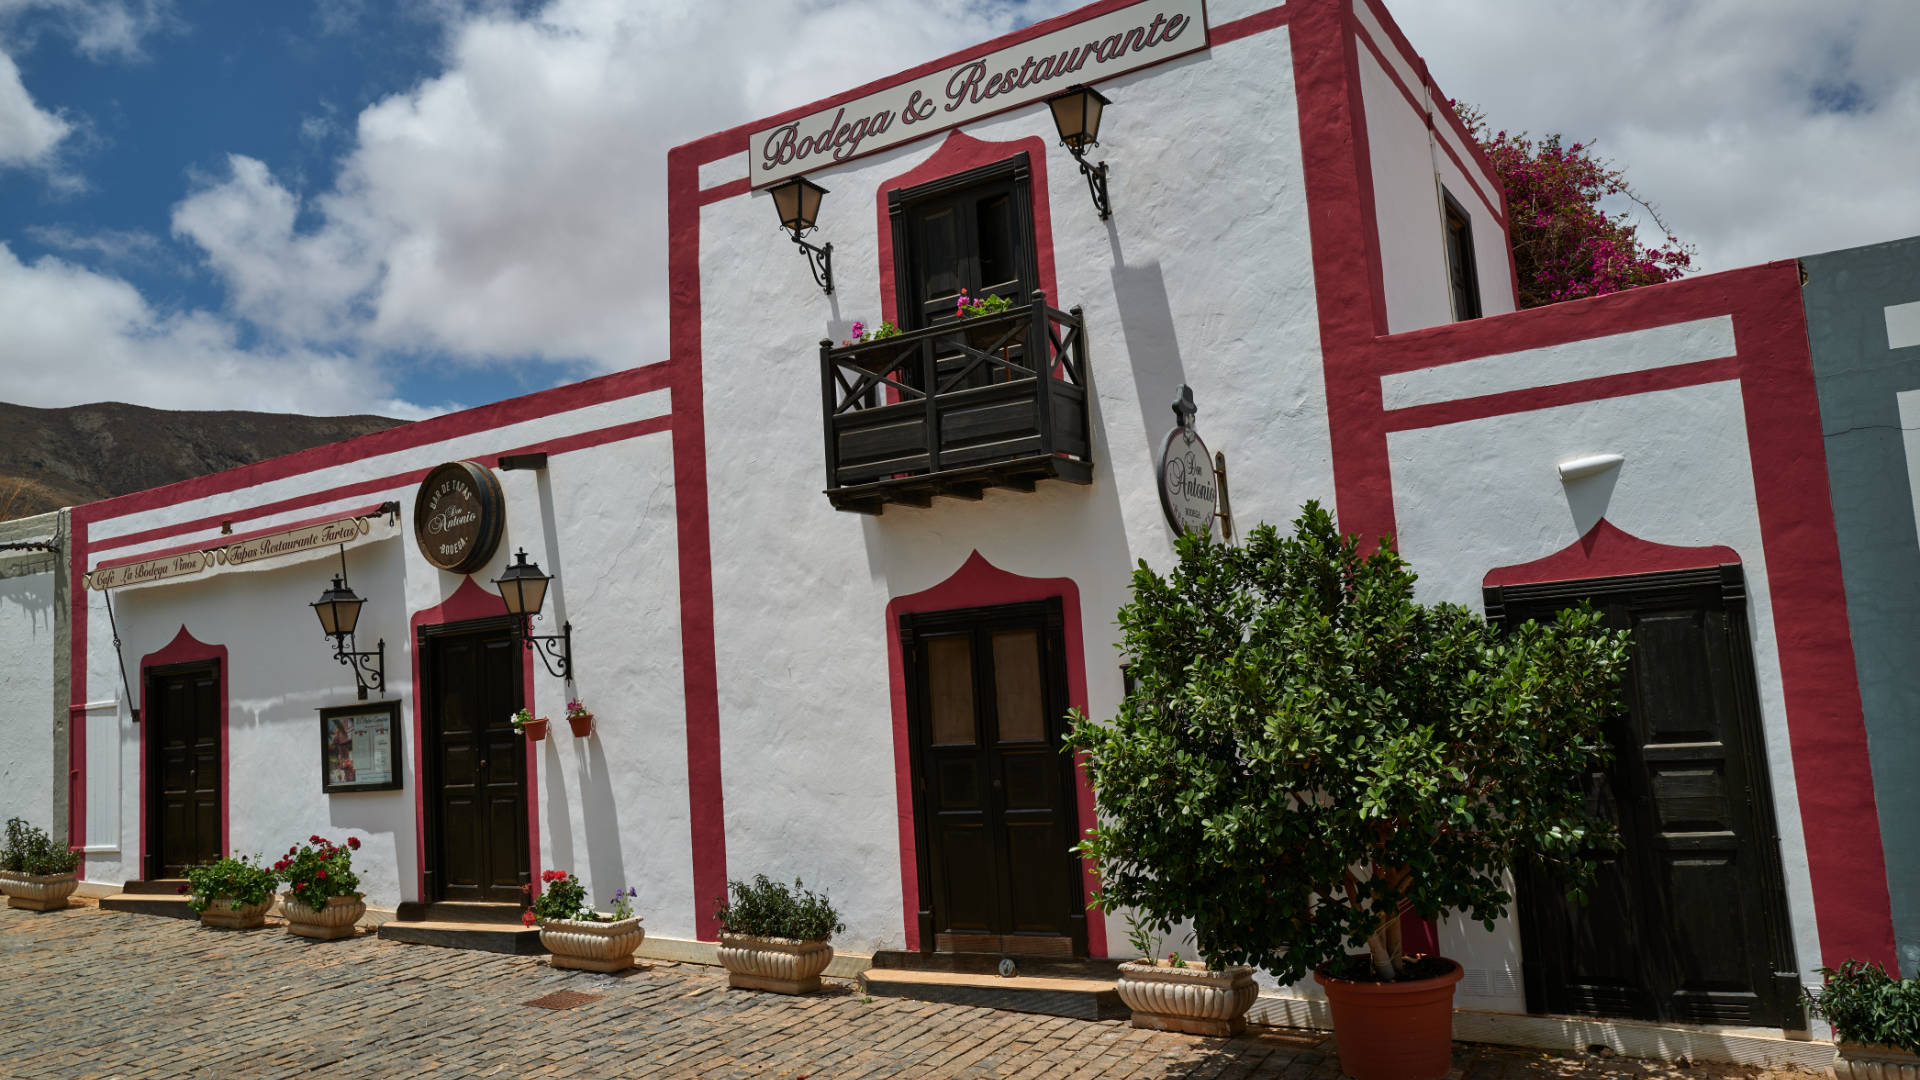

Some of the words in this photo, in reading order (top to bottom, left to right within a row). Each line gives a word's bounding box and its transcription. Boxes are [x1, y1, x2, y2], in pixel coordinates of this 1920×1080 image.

[762, 107, 896, 171] Bodega
[902, 90, 937, 125] &
[944, 12, 1191, 112] Restaurante
[1184, 450, 1202, 477] Don
[1167, 457, 1215, 502] Antonio
[429, 490, 442, 510] BAR
[441, 481, 451, 494] DE
[452, 479, 472, 501] TAPAS
[428, 511, 477, 535] Antonio
[447, 504, 462, 518] Don
[229, 545, 258, 562] Tapas
[260, 534, 318, 556] Restaurante
[321, 525, 355, 543] Tartas
[440, 537, 467, 555] BODEGA
[120, 567, 133, 583] La
[135, 560, 168, 580] Bodega
[172, 557, 197, 571] Vinos
